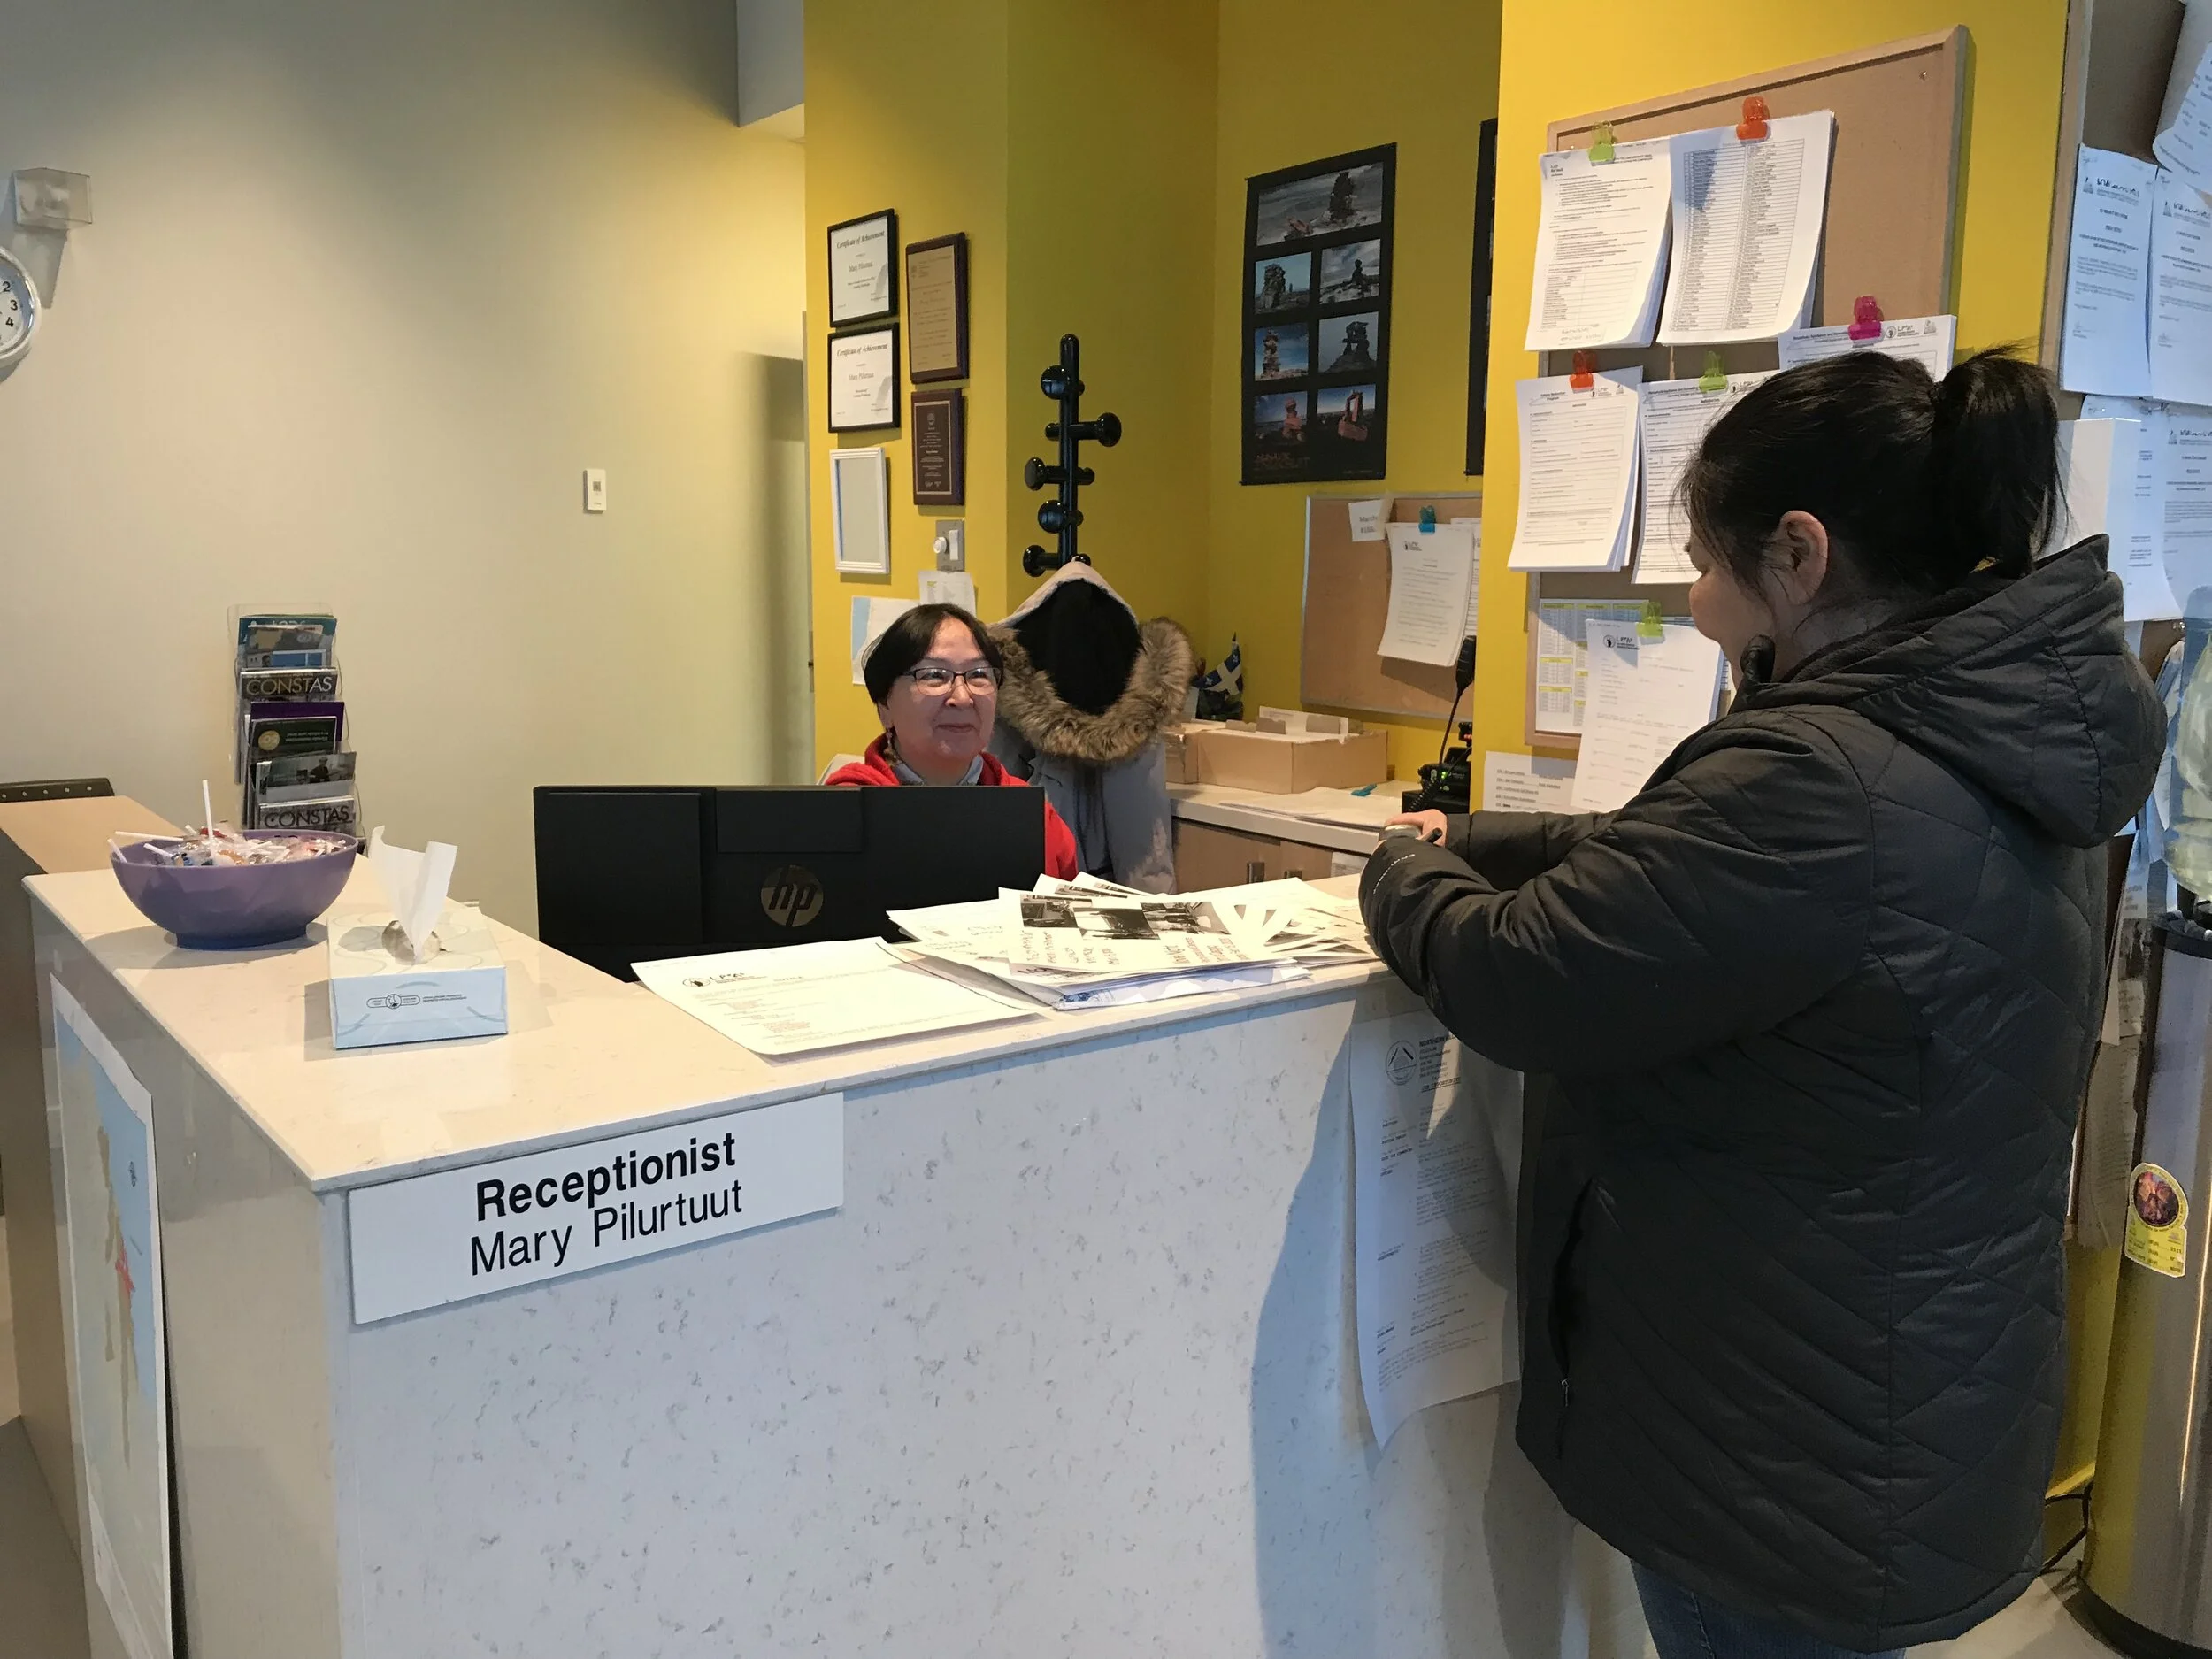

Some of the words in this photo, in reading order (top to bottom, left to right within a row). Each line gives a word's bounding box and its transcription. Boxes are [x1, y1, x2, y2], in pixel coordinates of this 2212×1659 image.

[3, 280, 11, 292] 2
[10, 299, 18, 311] 3
[5, 317, 14, 328] 4
[246, 676, 333, 696] CONSTAS
[264, 806, 351, 829] CONSTAS
[768, 865, 818, 927] hp
[476, 1132, 736, 1222] Receptionist
[471, 1225, 573, 1277] Mary
[593, 1179, 743, 1248] Pilurtuut
